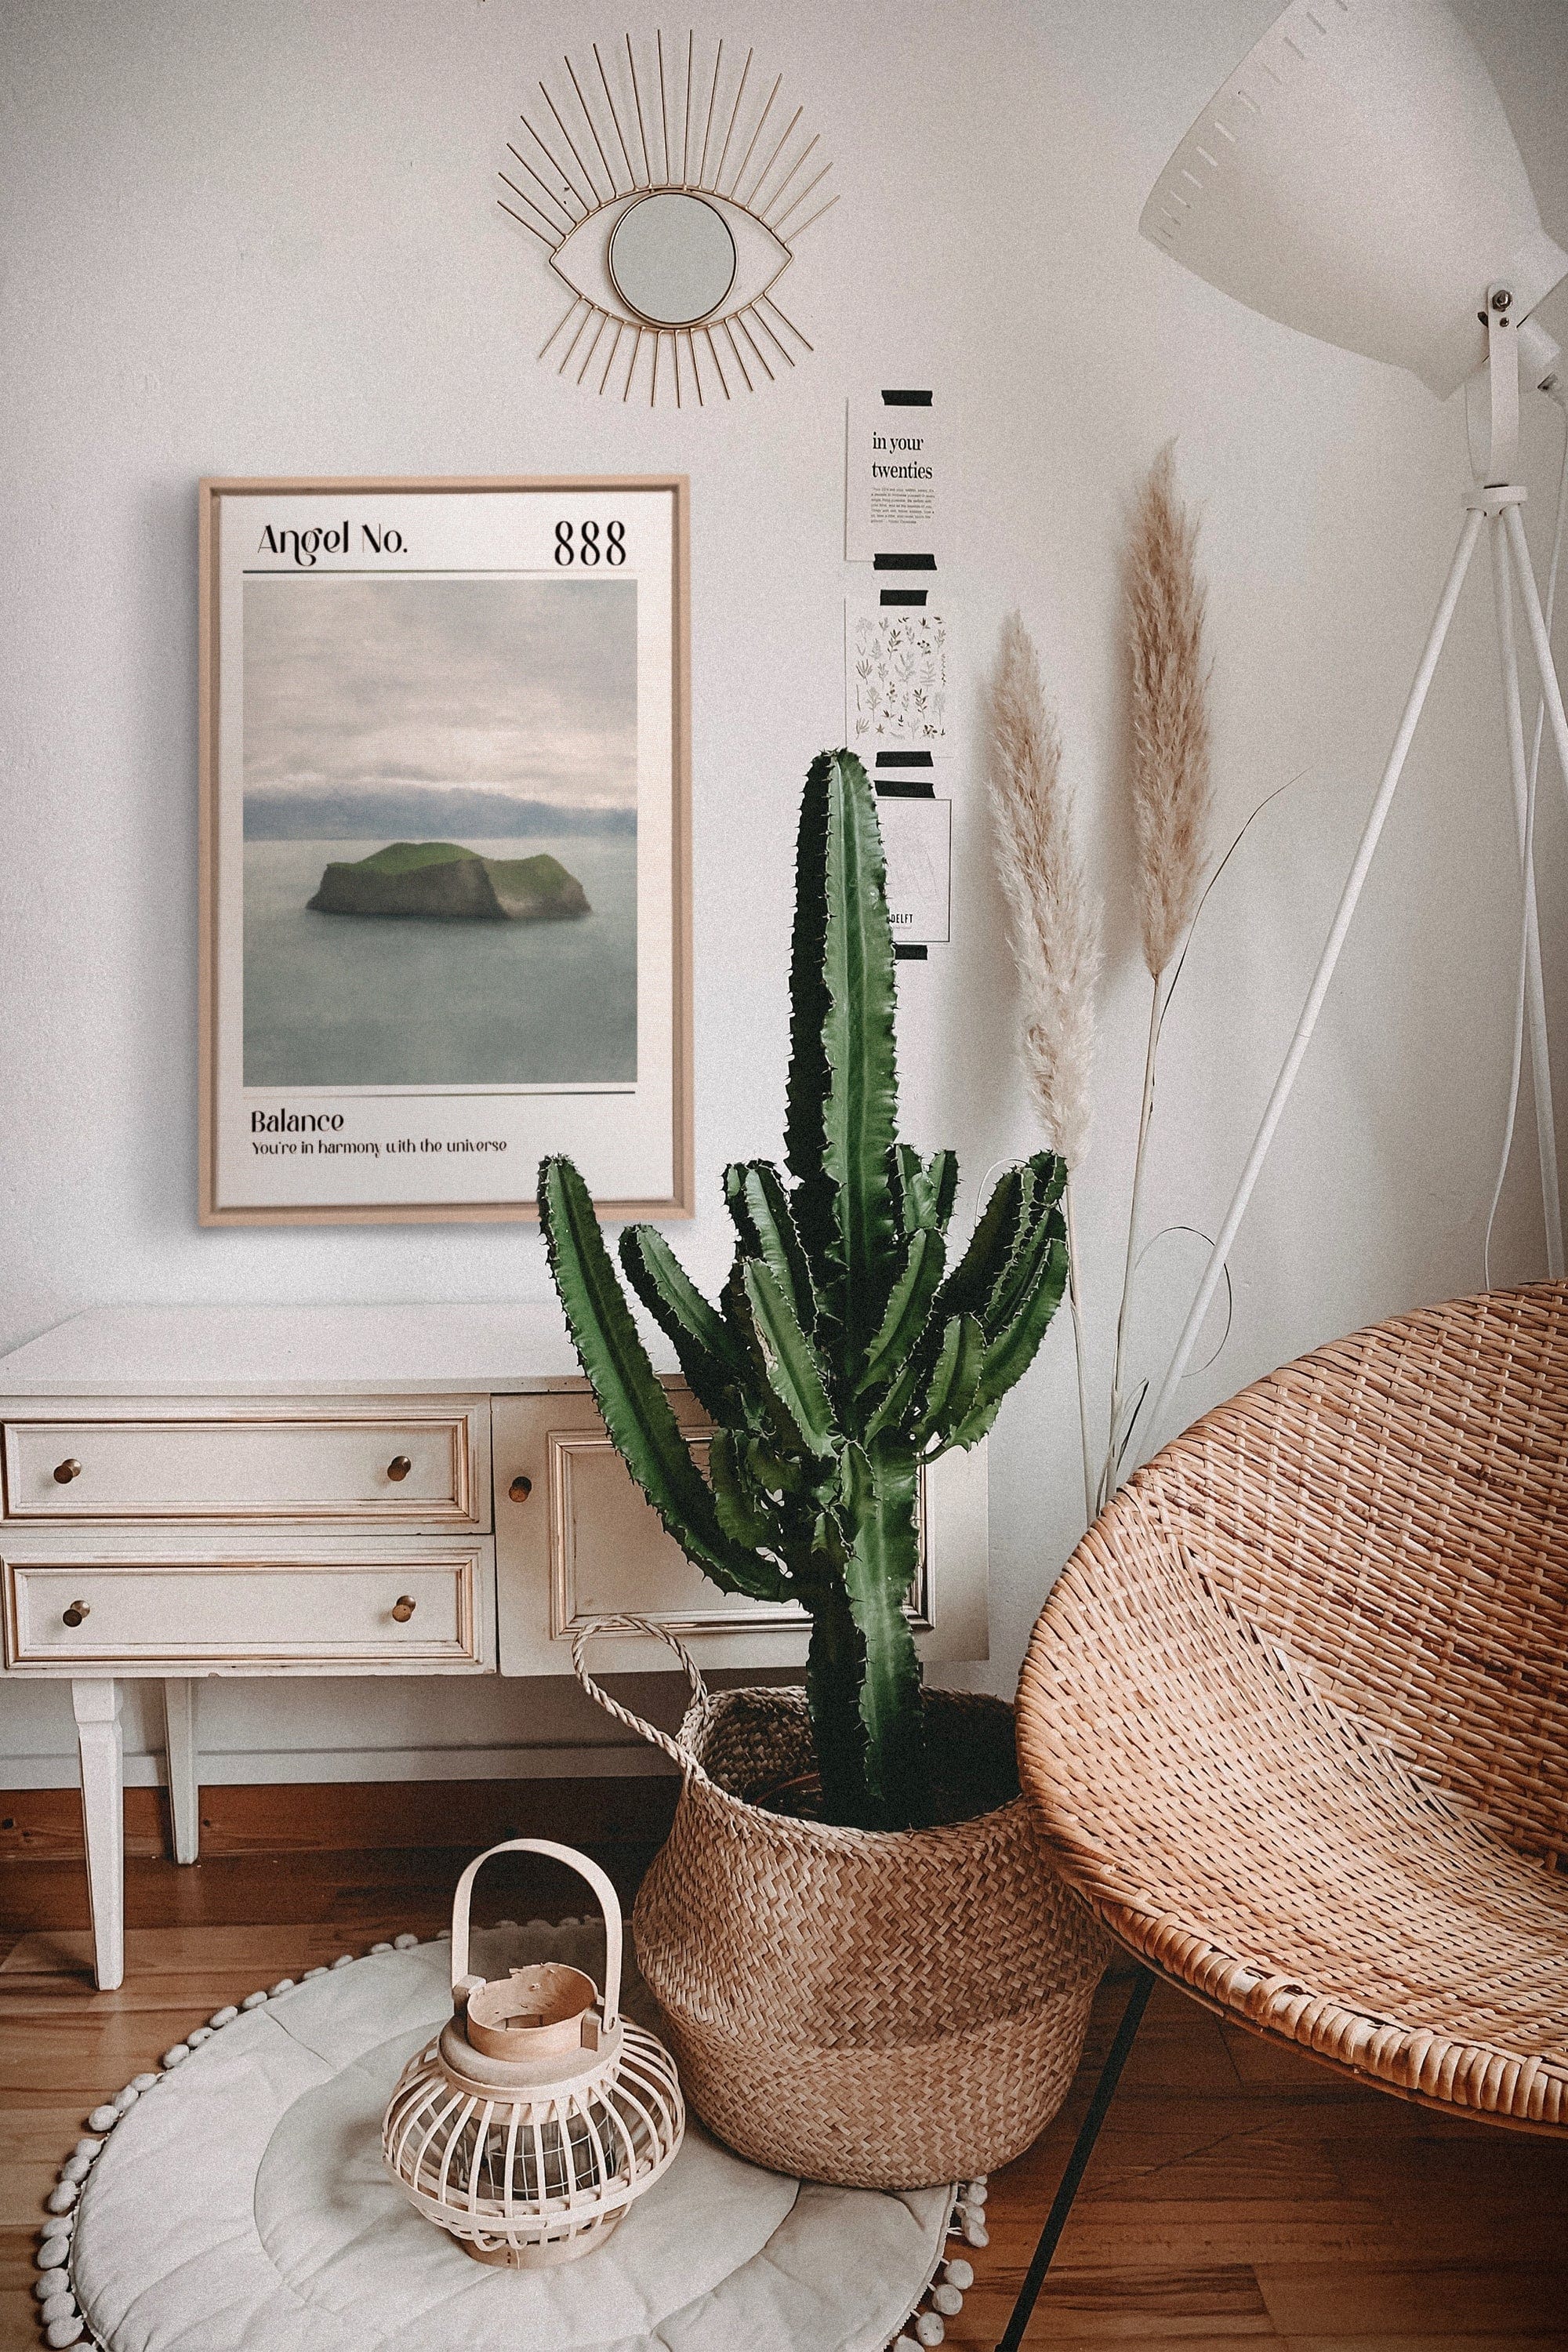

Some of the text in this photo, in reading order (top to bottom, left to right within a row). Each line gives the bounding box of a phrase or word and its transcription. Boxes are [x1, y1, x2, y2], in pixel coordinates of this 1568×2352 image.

[873, 431, 924, 455] in your
[871, 460, 933, 480] twenties
[257, 520, 408, 567] Angel No.
[554, 520, 627, 566] 888
[891, 913, 913, 924] DELFT
[251, 1108, 345, 1134] Balance
[252, 1138, 507, 1159] You're in harmony with the universe
